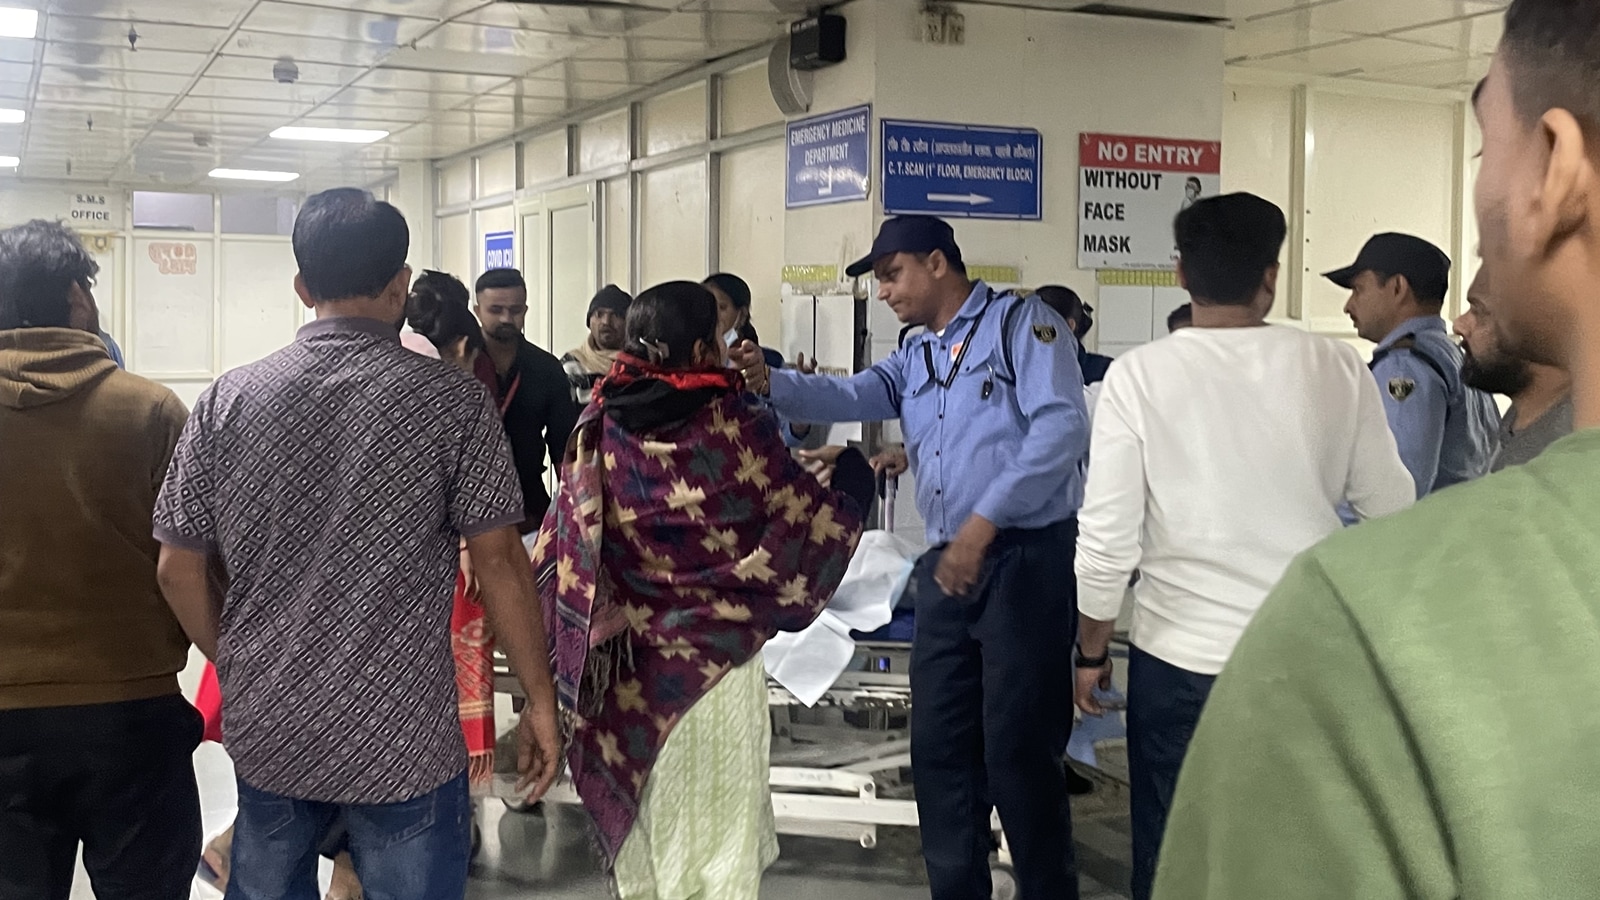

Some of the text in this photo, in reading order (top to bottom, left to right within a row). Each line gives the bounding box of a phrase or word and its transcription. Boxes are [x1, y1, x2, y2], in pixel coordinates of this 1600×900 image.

[791, 115, 866, 146] EMERGENCY MEDICINE
[804, 142, 849, 166] DEPARTMENT
[1098, 140, 1204, 166] NO ENTRY
[963, 165, 1005, 180] EMERGENCY
[1006, 167, 1033, 184] BLOCK)
[1084, 169, 1162, 191] WITHOUT
[76, 194, 106, 205] S.M.S
[71, 210, 110, 221] OFFICE
[1084, 201, 1125, 221] FACE
[1083, 234, 1131, 254] MASK
